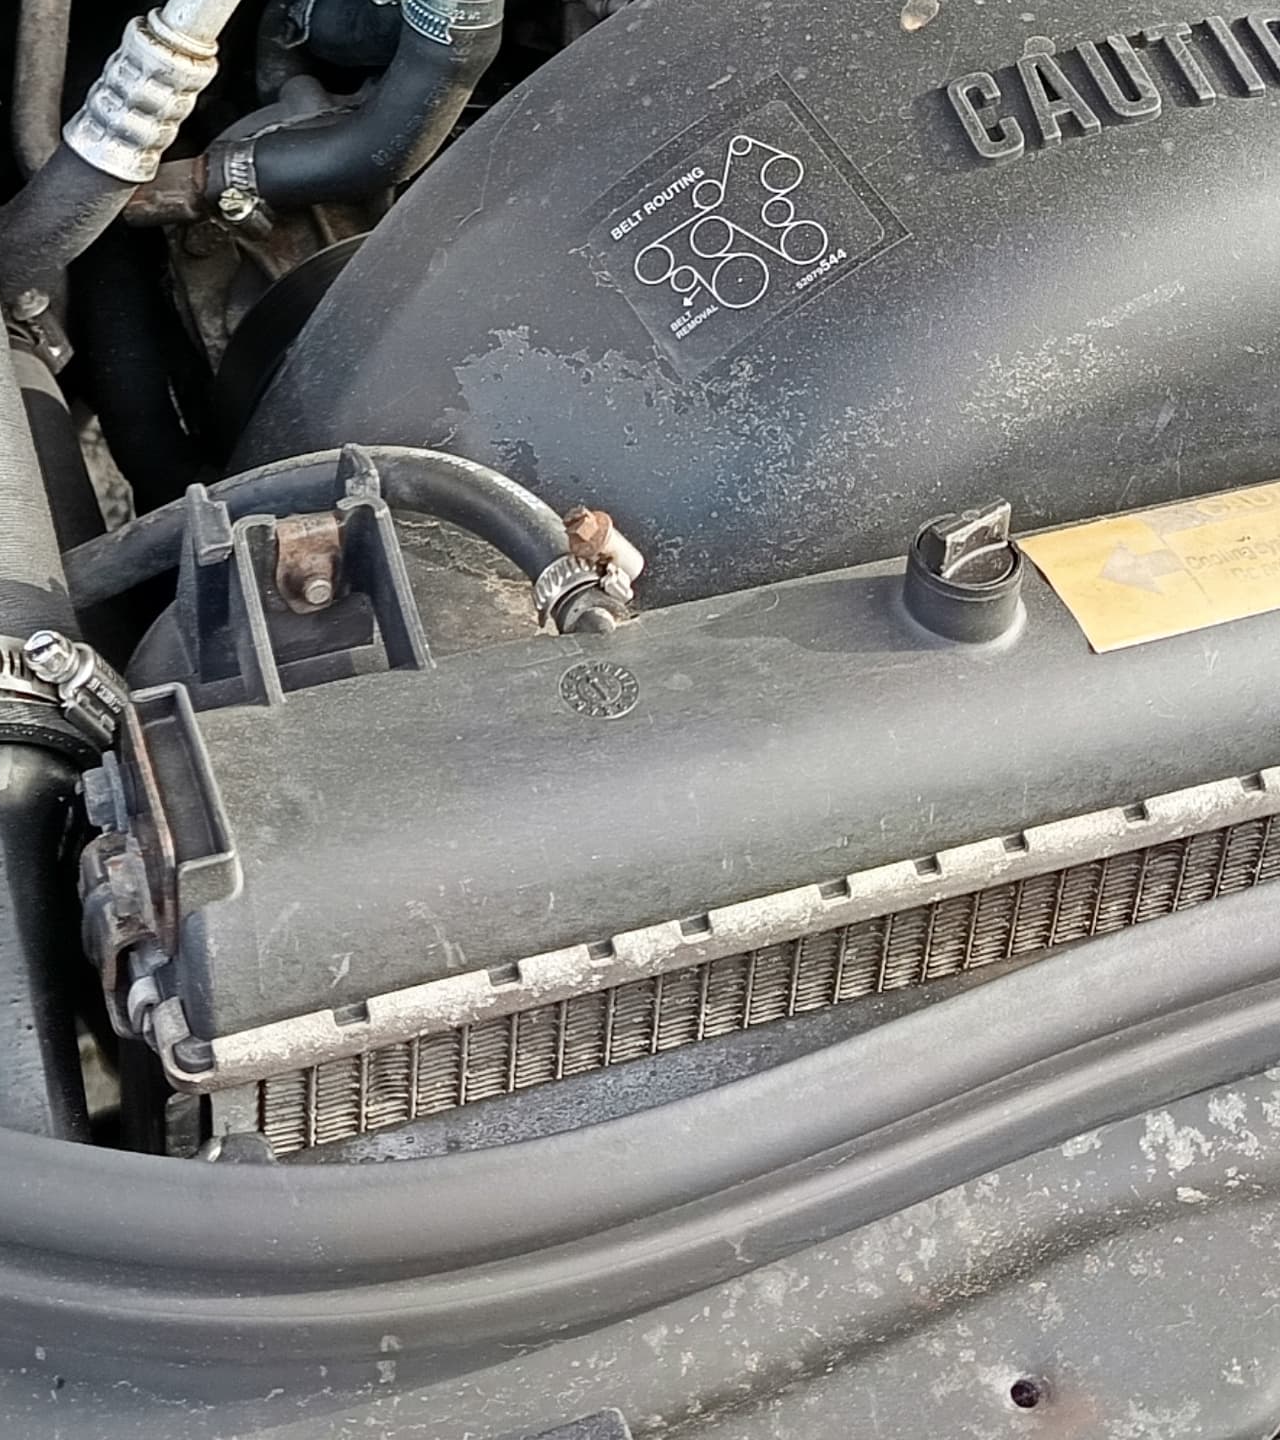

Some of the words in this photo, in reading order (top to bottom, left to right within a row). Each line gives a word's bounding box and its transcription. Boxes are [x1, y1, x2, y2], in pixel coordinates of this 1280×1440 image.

[609, 210, 644, 242] BELT
[643, 165, 706, 217] ROUTING
[669, 310, 695, 334] BELT
[674, 302, 720, 341] REMOVAL
[1185, 544, 1257, 570] Cooling
